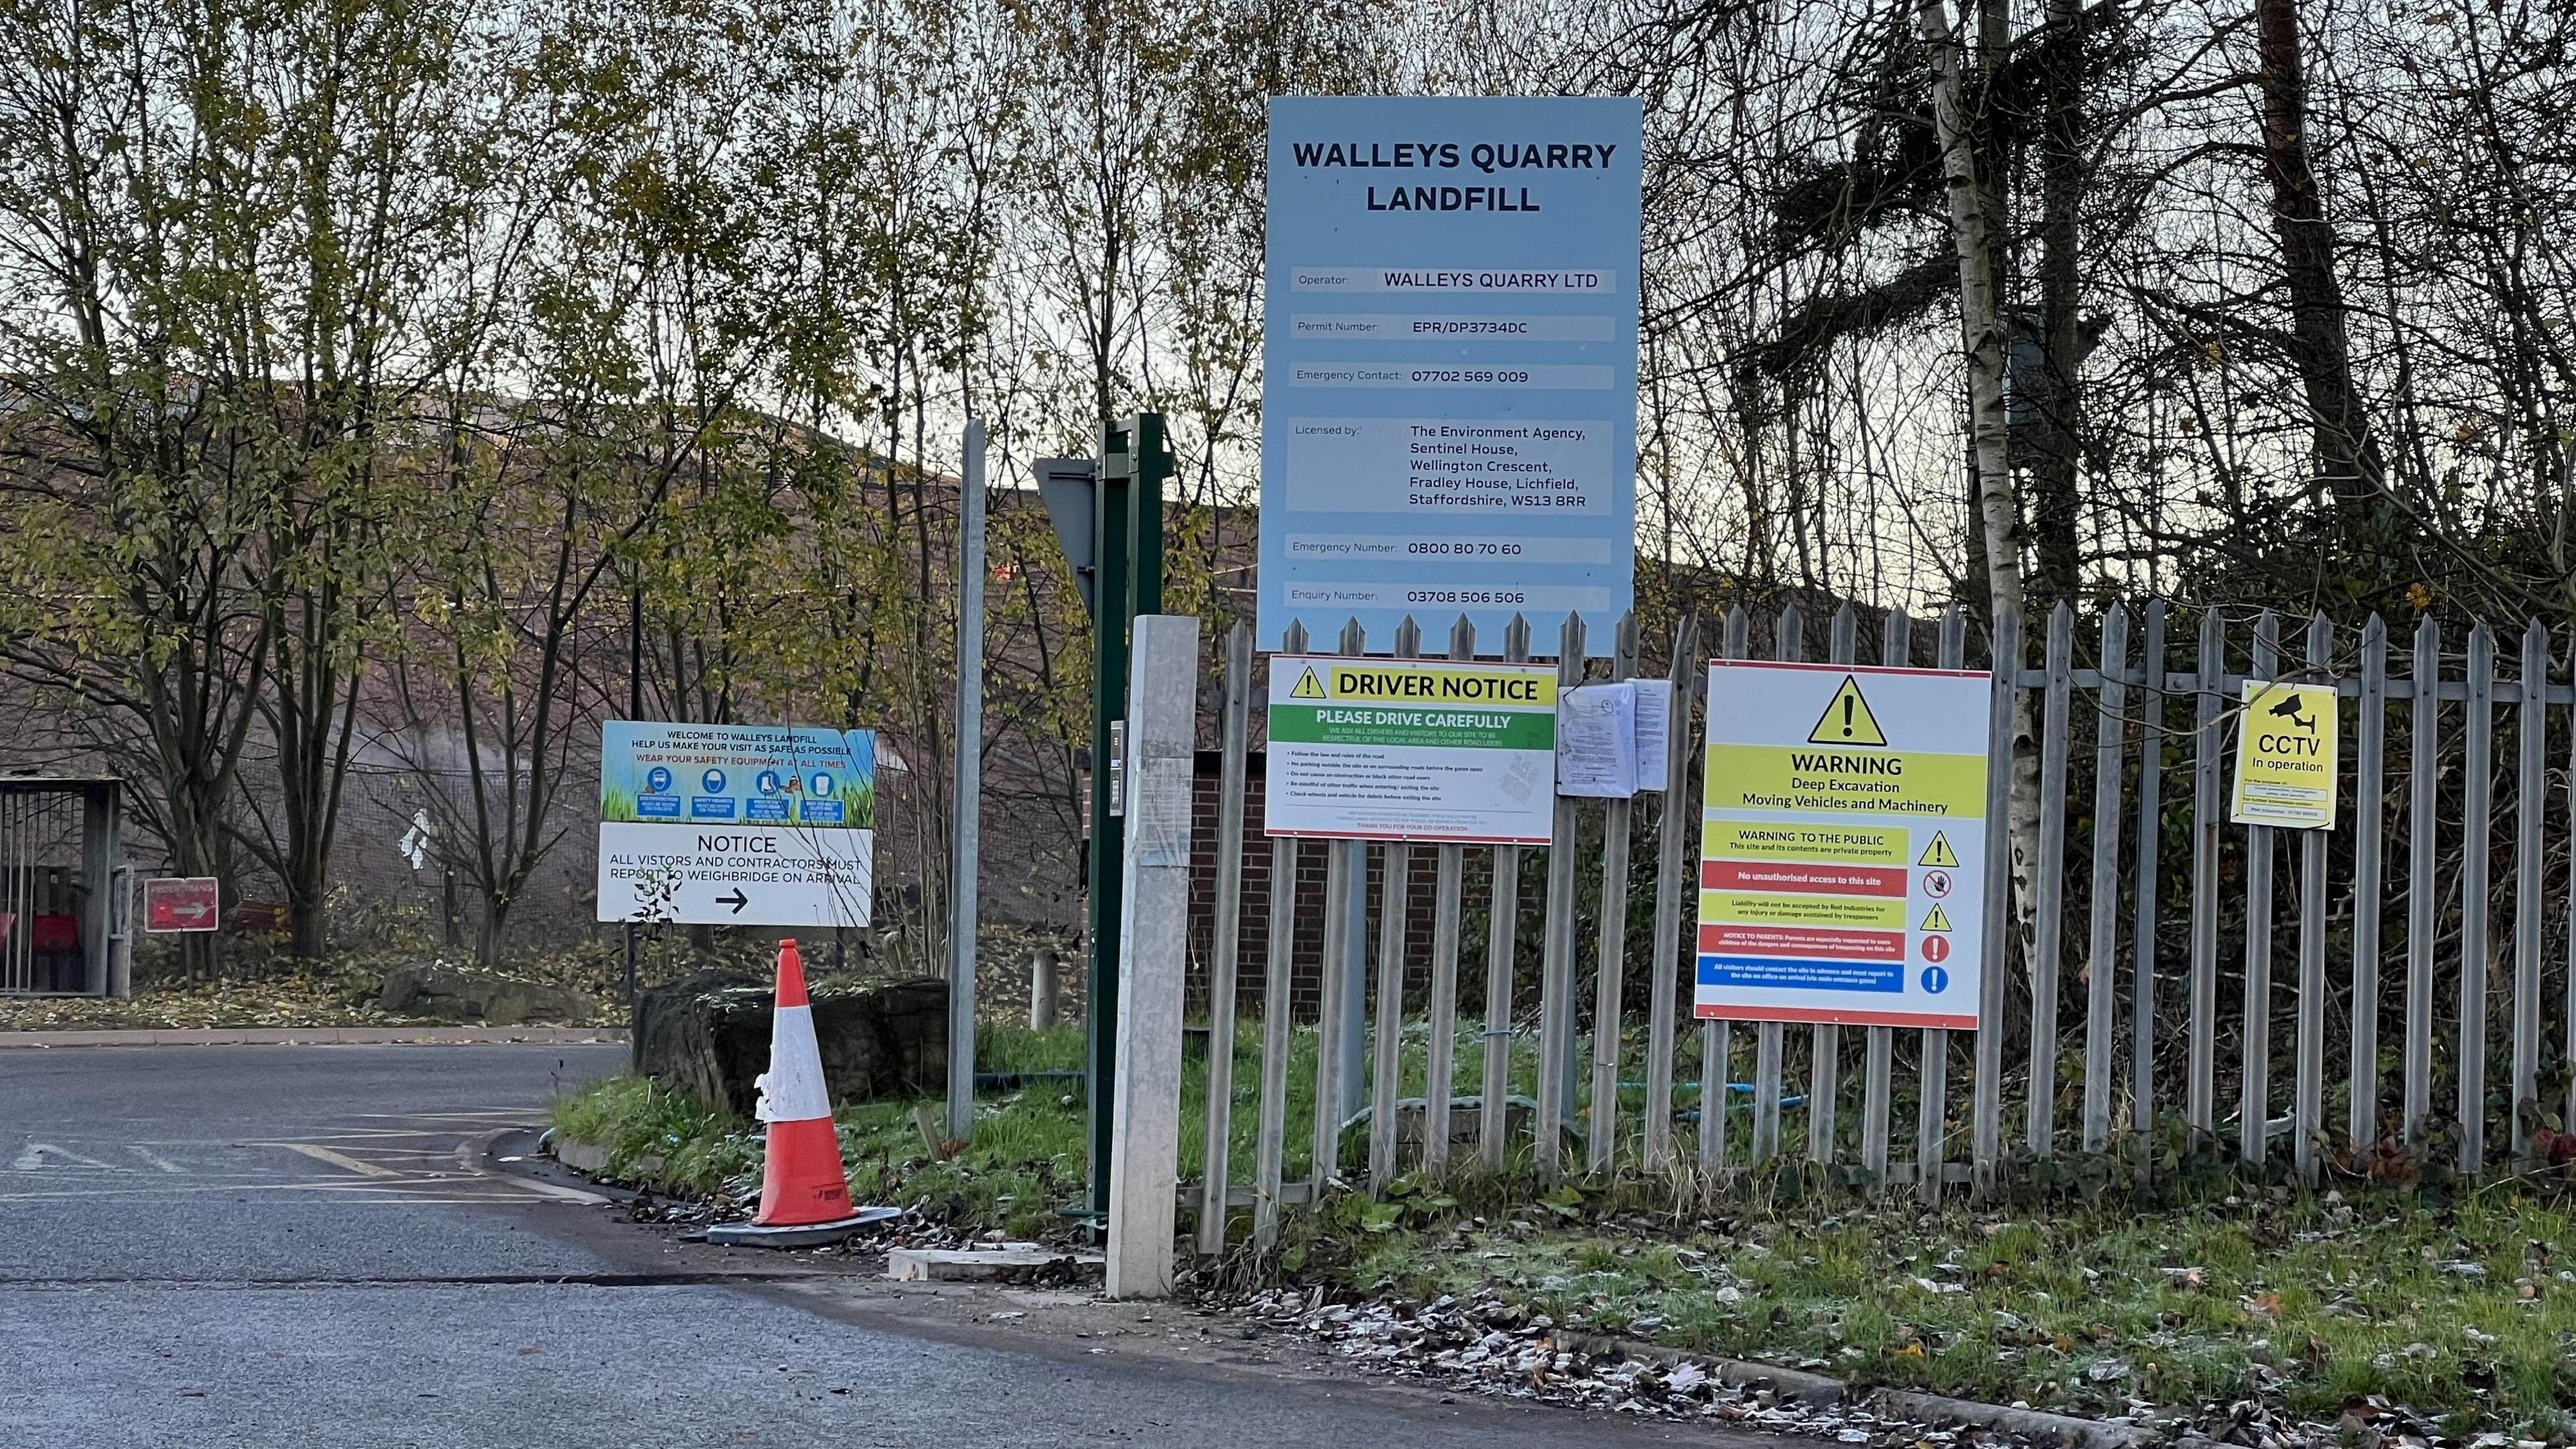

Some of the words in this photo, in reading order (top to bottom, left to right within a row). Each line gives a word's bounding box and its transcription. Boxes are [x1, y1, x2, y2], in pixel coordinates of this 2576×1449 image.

[1293, 143, 1460, 167] WALLEYS
[1470, 144, 1617, 173] QUARRY
[1367, 186, 1540, 211] LANDFILL
[1298, 274, 1349, 284] Operator:
[1385, 273, 1473, 286] WALLEYS
[1480, 273, 1559, 287] QUARRY
[1564, 274, 1598, 288] LTD
[1297, 322, 1332, 331] Permit
[1336, 323, 1379, 331] Number:
[1413, 322, 1527, 333] EPR/DP3734DC
[1297, 370, 1355, 381] Emergency
[1357, 370, 1402, 380] Contact:
[1411, 371, 1460, 382] 07702
[1464, 371, 1493, 382] 569
[1497, 372, 1528, 382] 009
[1295, 426, 1342, 435] Licensed
[1344, 426, 1362, 437] by:
[1410, 425, 1436, 437] The
[1441, 426, 1528, 437] Environment
[1532, 427, 1585, 441] Agency,
[1410, 443, 1466, 454] Sentinel
[1472, 443, 1517, 456] House,
[1410, 460, 1483, 474] Wellington
[1487, 461, 1552, 474] Crescent,
[1410, 477, 1461, 490] Fradley
[1466, 478, 1511, 490] House,
[1516, 478, 1578, 490] Lichfield,
[1409, 494, 1507, 506] Staffordshire,
[1511, 495, 1551, 506] WS13
[1556, 496, 1586, 506] 8RR
[1293, 542, 1351, 553] Emergency
[1353, 543, 1397, 552] Number:
[1408, 543, 1449, 553] 0800
[1454, 543, 1474, 554] 80
[1478, 543, 1497, 554] 70
[1501, 544, 1521, 555] 60
[1292, 590, 1331, 601] Enquiry
[1334, 590, 1379, 600] Number:
[1407, 592, 1456, 602] 03708
[1460, 592, 1490, 602] 506
[1495, 592, 1524, 603] 506
[1340, 674, 1435, 696] DRIVER
[1442, 678, 1538, 700] NOTICE
[1316, 710, 1373, 724] PLEASE
[1375, 712, 1422, 726] DRIVE
[1425, 714, 1511, 729] CAREFULLY
[667, 731, 714, 740] WELCOME
[716, 733, 729, 741] TO
[731, 733, 773, 742] WALLEYS
[775, 735, 817, 743] LANDFILL
[657, 741, 670, 749] US
[673, 741, 699, 750] MAKE
[701, 743, 727, 751] YOUR
[729, 743, 752, 751] VISIT
[769, 745, 792, 753] SAFE
[793, 746, 806, 754] AS
[2259, 735, 2320, 756] CCTV
[636, 754, 663, 762] WEAR
[694, 756, 729, 764] SAFETY
[820, 760, 846, 769] TIMES
[1791, 754, 1902, 775] WARNING
[2253, 757, 2263, 767] In
[2267, 761, 2323, 771] operation
[1792, 777, 1825, 792] Deep
[1829, 779, 1899, 792] Excavation
[1743, 793, 1792, 808] Moving
[1794, 795, 1847, 808] Vehicles
[1851, 798, 1874, 809] and
[1878, 798, 1948, 814] Machinery
[698, 835, 777, 853] NOTICE
[1739, 830, 1795, 841] WARNING
[1801, 833, 1816, 843] TO
[1818, 833, 1841, 843] THE
[1843, 835, 1884, 845] PUBLIC
[610, 854, 633, 865] ALL
[638, 855, 692, 866] VISTORS
[695, 856, 723, 867] AND
[728, 857, 822, 869] CONTRACTORS
[610, 868, 660, 880] REPORT
[688, 871, 778, 882] WEIGHBRIDGE
[782, 873, 802, 883] ON
[1737, 871, 1751, 879] No
[1752, 873, 1808, 882] unauthorised
[1837, 876, 1847, 884] to
[1848, 876, 1864, 885] this
[1866, 877, 1881, 885] site
